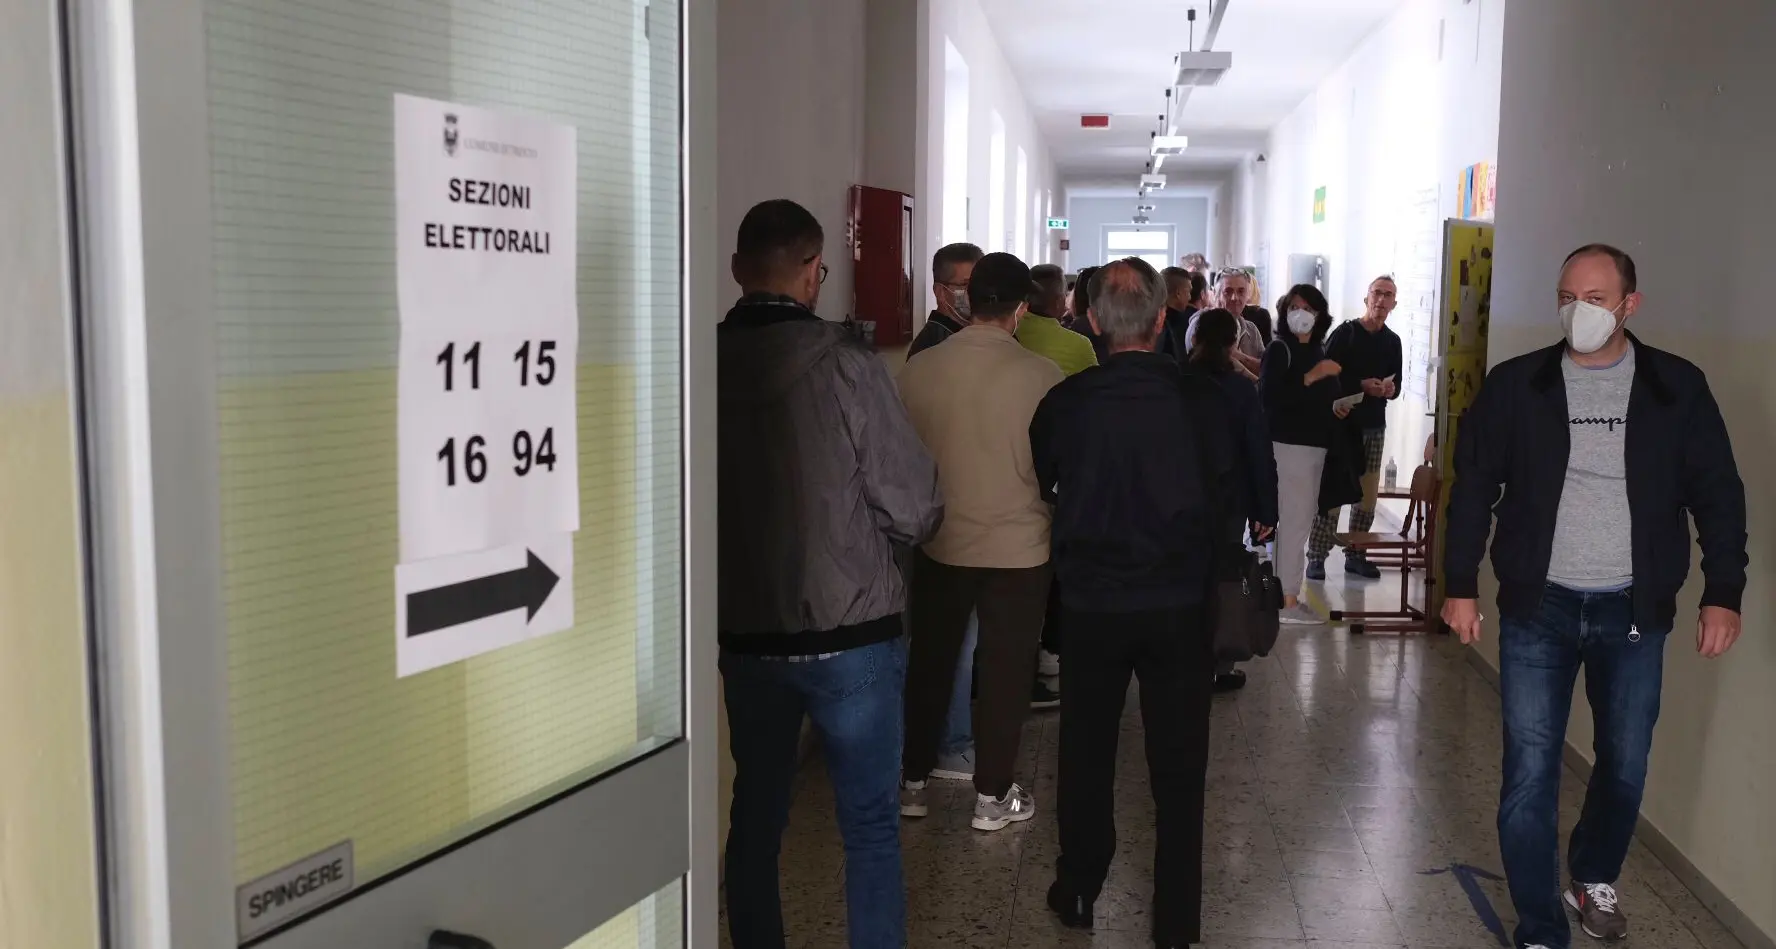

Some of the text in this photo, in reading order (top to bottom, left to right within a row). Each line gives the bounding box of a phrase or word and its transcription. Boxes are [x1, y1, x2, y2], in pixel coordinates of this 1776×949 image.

[449, 178, 530, 209] SEZIONI
[424, 223, 550, 254] ELETTORALI
[437, 340, 556, 391] 11 15
[437, 427, 556, 486] 16 94
[248, 858, 343, 919] SPINGERE
